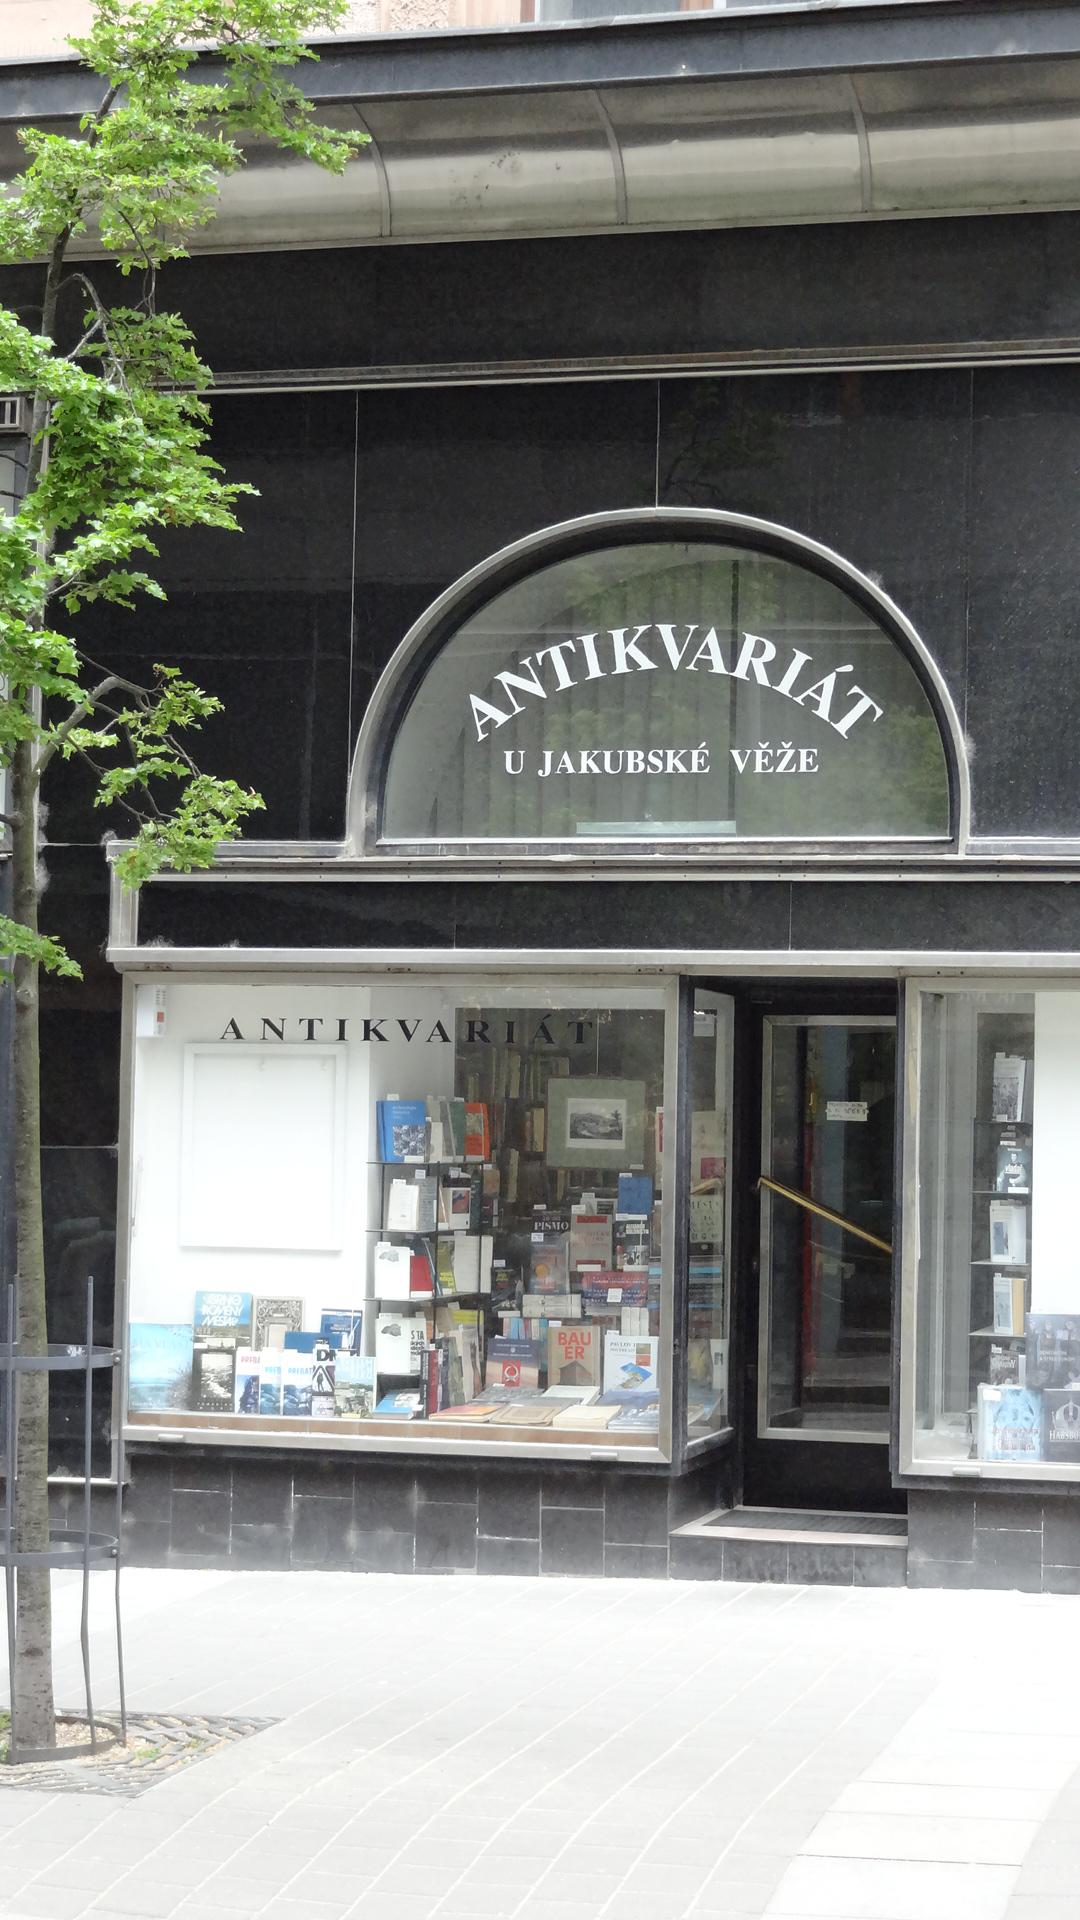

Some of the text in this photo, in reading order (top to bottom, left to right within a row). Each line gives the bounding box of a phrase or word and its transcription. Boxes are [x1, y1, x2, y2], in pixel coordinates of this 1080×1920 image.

[469, 624, 884, 742] ANTIKVARIÁT
[504, 742, 819, 777] U JAKUBSKÉ VĚŽE
[220, 1013, 593, 1045] ANTIKVARIÁT
[557, 1331, 592, 1345] BAU
[564, 1346, 585, 1360] ER
